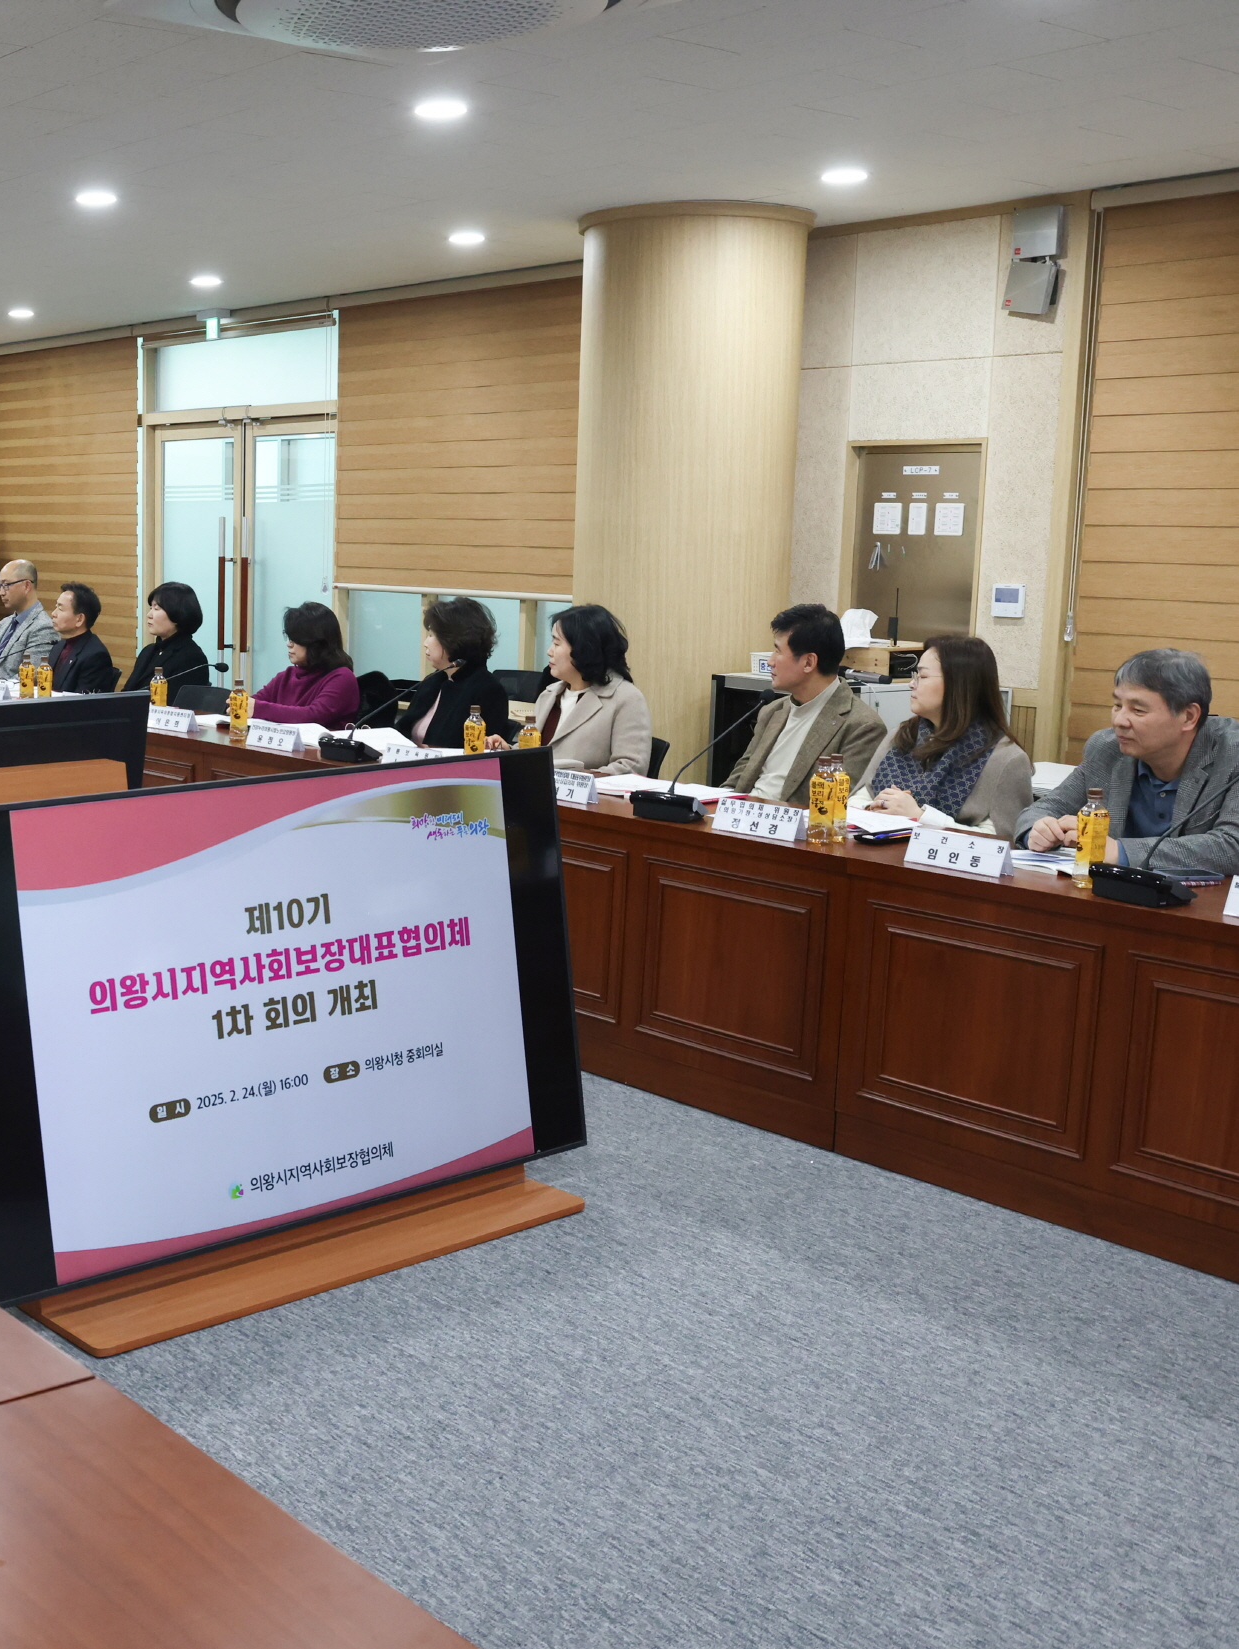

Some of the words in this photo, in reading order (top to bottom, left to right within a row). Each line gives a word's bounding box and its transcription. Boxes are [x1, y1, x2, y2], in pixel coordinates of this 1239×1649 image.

[469, 818, 490, 836] 의왕
[731, 817, 778, 835] 정선경
[774, 806, 800, 817] 위원장
[927, 848, 982, 868] 임인동
[244, 893, 332, 935] 제10기
[87, 916, 471, 1016] 의왕시지역사회보장대표협의체
[211, 1003, 254, 1040] 1차
[263, 991, 317, 1031] 회의
[327, 979, 378, 1017] 개최
[330, 1063, 356, 1079] 장소
[364, 1051, 404, 1072] 의왕시청
[406, 1042, 444, 1064] 중회의실
[156, 1101, 186, 1119] 일시
[196, 1092, 227, 1110] 2025.
[229, 1090, 240, 1102] 2.
[242, 1079, 277, 1100] 24.(월)
[279, 1073, 309, 1091] 16:00
[250, 1141, 394, 1193] 의왕시지역사회보장협의체
